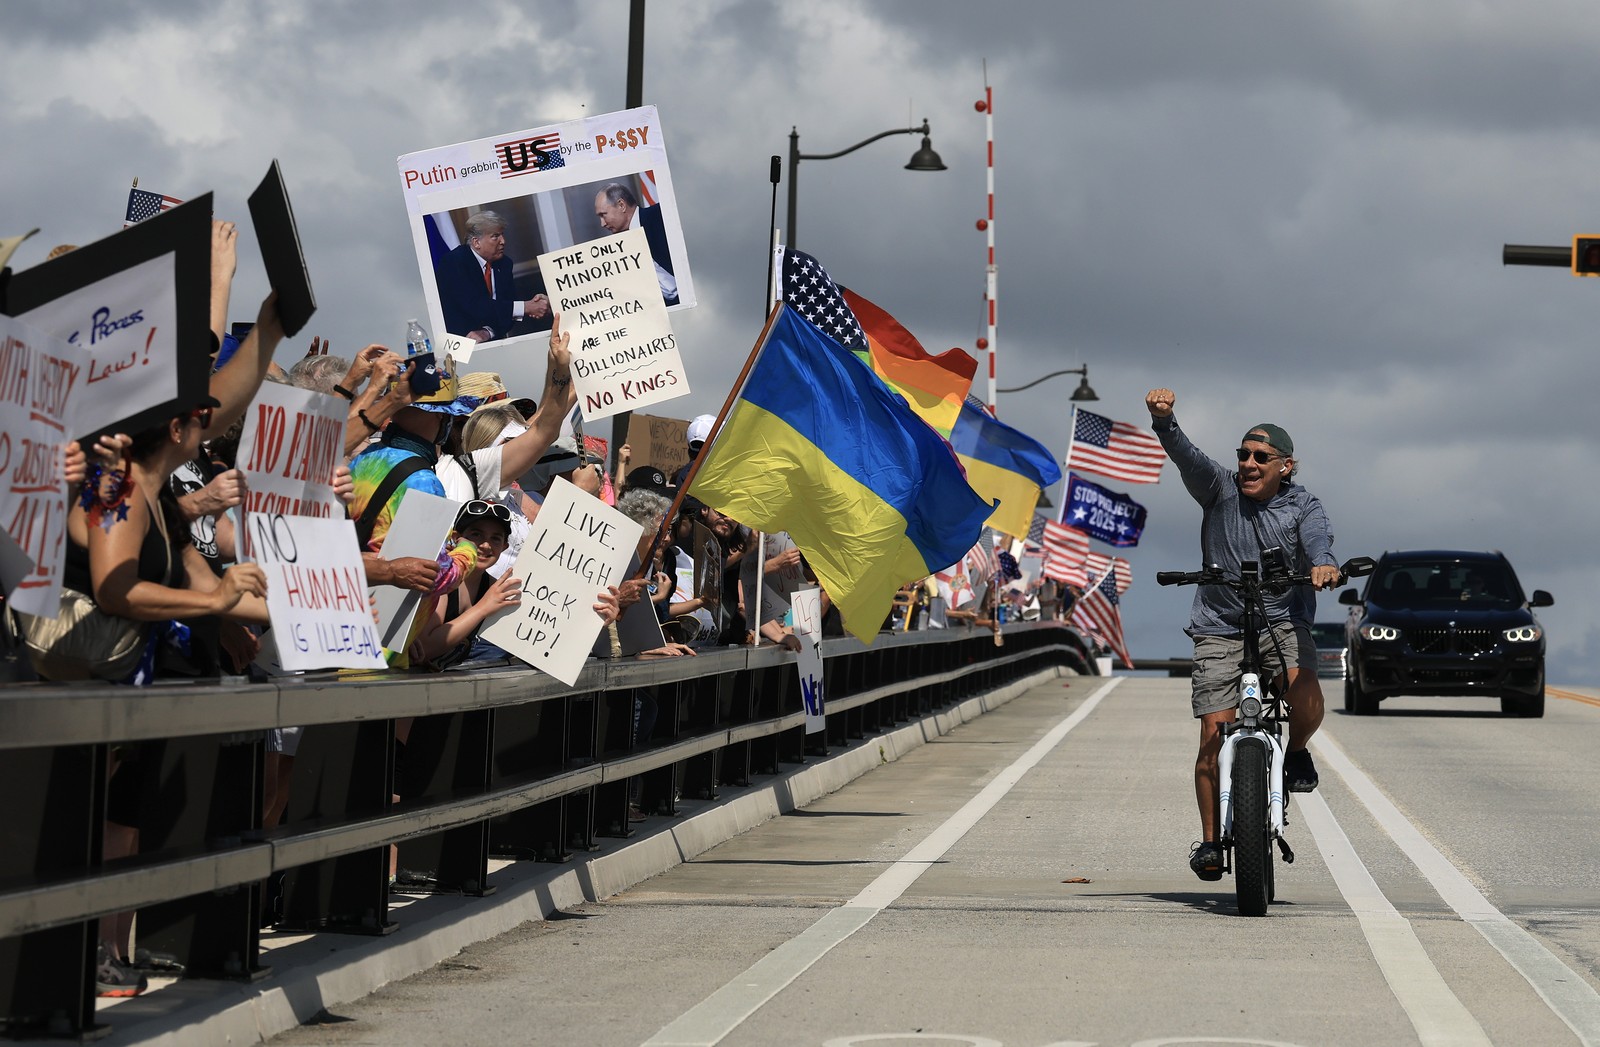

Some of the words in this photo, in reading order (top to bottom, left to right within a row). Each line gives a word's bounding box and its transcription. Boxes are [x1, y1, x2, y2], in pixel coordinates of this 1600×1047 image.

[404, 164, 457, 189] Putin
[503, 139, 550, 171] US
[560, 145, 572, 154] by
[575, 141, 591, 151] the
[553, 251, 584, 269] THE
[590, 240, 624, 258] ONLY
[556, 252, 641, 291] MINORITY
[560, 287, 614, 311] RUINING
[579, 299, 643, 328] AMERICA
[444, 339, 461, 351] NO
[573, 333, 676, 379] BILLIONAIRES
[581, 337, 600, 351] ARE
[606, 327, 628, 342] THE
[585, 391, 614, 413] NO
[620, 370, 678, 401] KINGS
[247, 404, 286, 474] NO
[1074, 485, 1098, 504] STOP
[1097, 493, 1140, 519] PROJECT
[1088, 506, 1116, 532] 2025
[257, 513, 297, 563] NO
[563, 502, 617, 551] LIVE.
[281, 565, 365, 613] HUMAN
[522, 572, 577, 620] LOCK
[528, 605, 557, 629] HIM
[290, 623, 309, 652] IS
[315, 623, 382, 659] ILLEGAL
[515, 622, 561, 658] UP!
